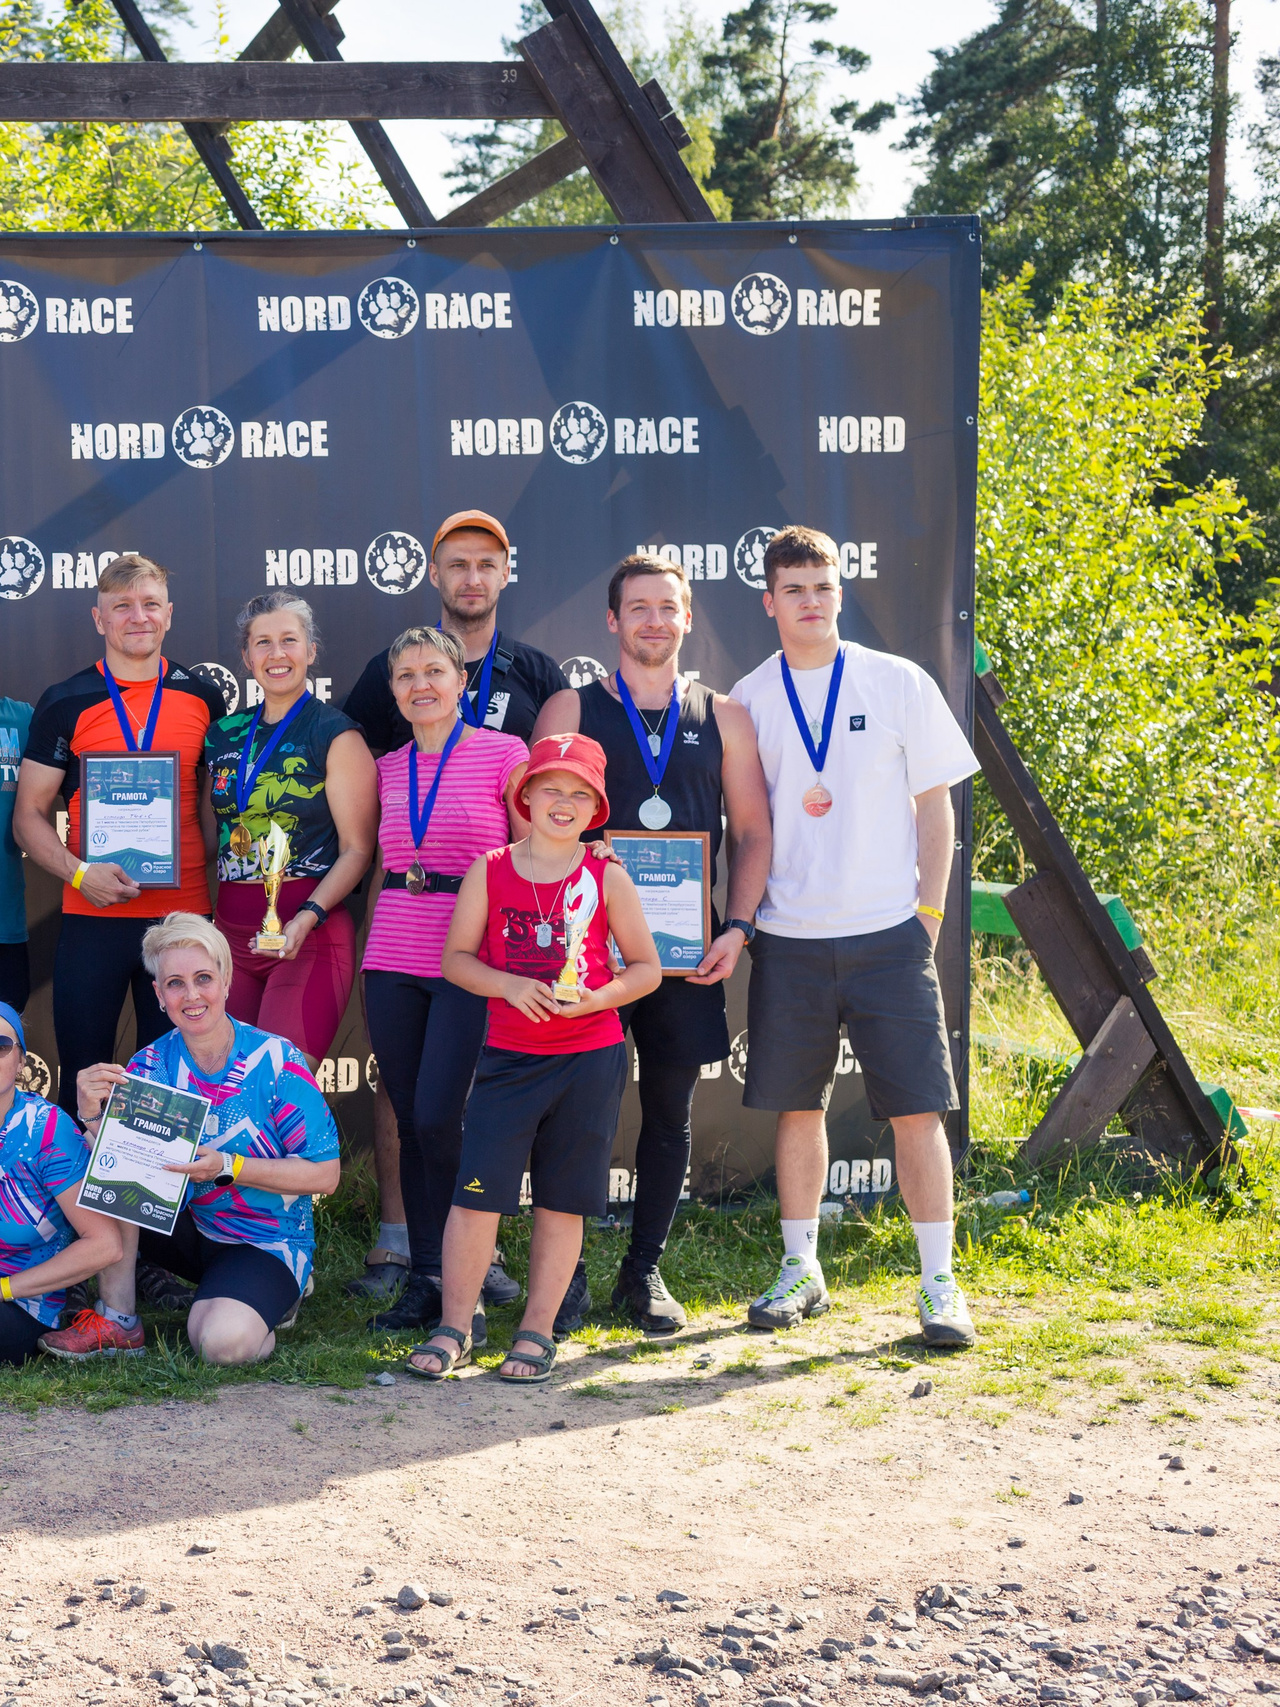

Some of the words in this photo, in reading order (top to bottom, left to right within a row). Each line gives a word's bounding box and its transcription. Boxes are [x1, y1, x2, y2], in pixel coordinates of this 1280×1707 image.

[46, 298, 133, 334] RACE
[258, 296, 351, 332] NORD
[426, 293, 512, 329] RACE
[634, 289, 725, 327] NORD
[797, 289, 881, 326] RACE
[71, 423, 165, 460] NORD
[241, 421, 328, 458] RACE
[451, 418, 543, 456] NORD
[615, 417, 699, 454] RACE
[819, 416, 905, 453] NORD
[266, 549, 358, 586] NORD
[111, 792, 148, 801] ГРАМОТА
[639, 873, 677, 882] ГРАМОТА
[133, 1117, 172, 1136] ГРАМОТА
[83, 1190, 99, 1201] RACE
[86, 1183, 102, 1194] NORD
